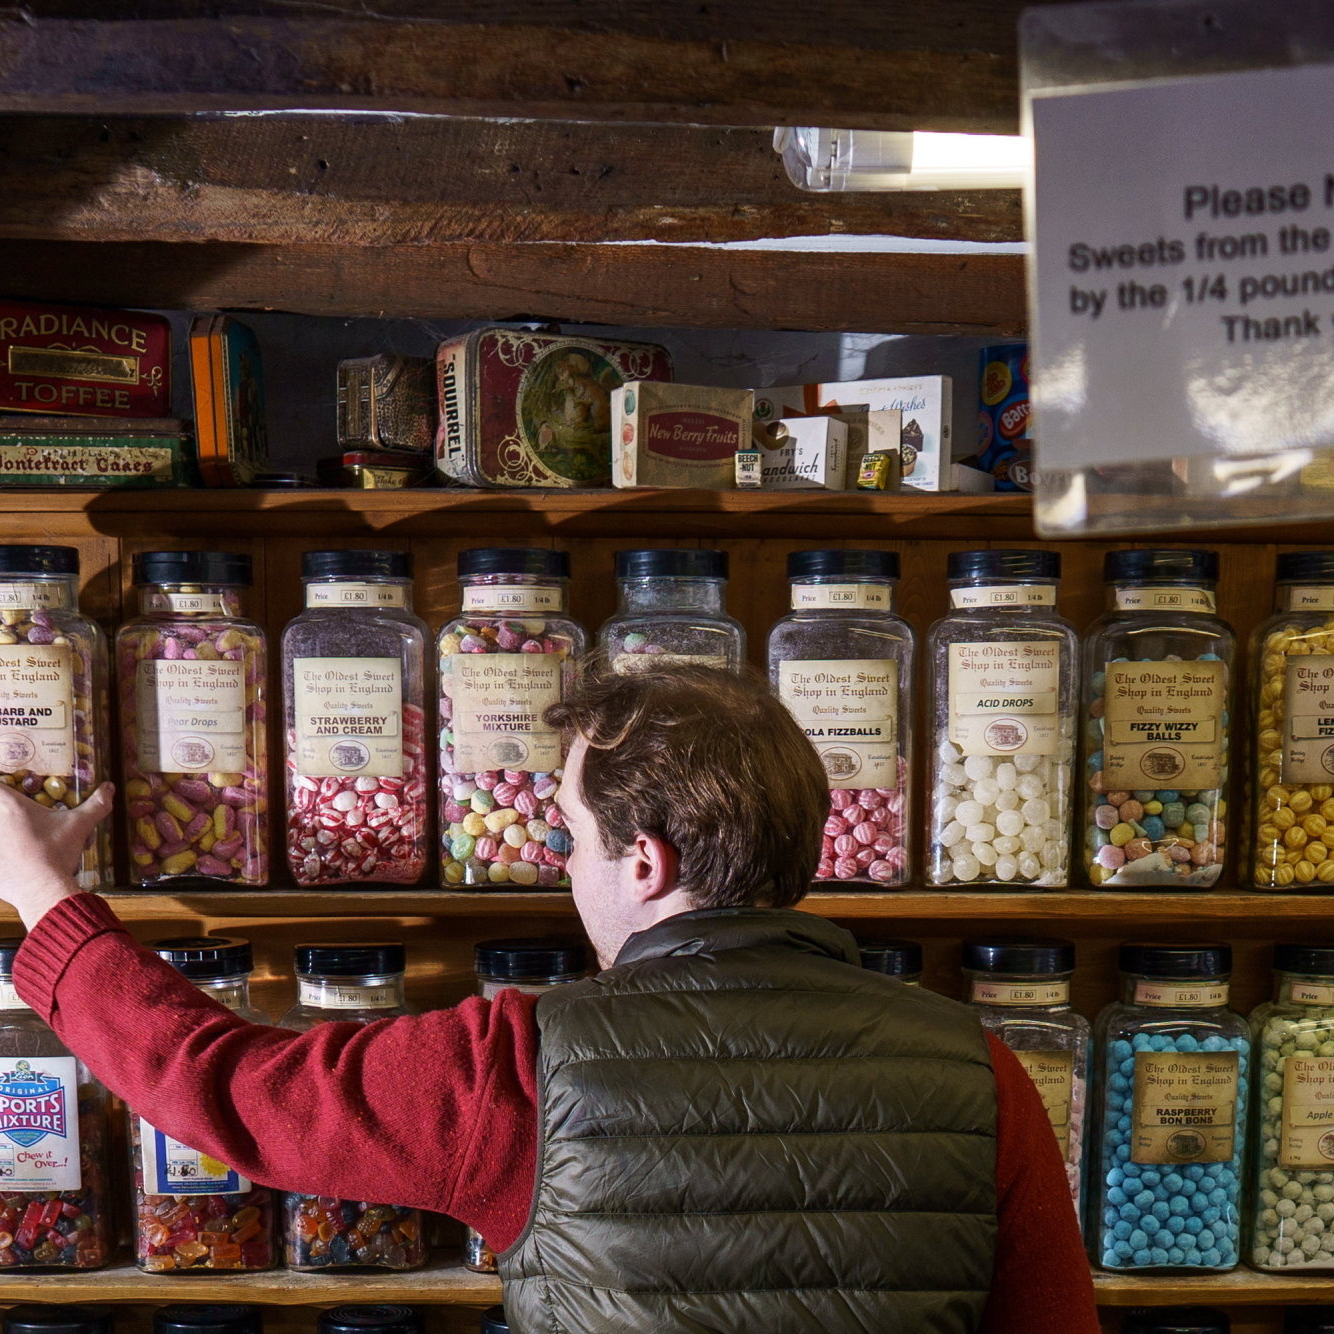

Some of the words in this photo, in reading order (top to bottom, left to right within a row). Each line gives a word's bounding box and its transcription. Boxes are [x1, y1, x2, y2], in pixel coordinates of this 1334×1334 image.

[1184, 180, 1310, 219] Please
[1070, 241, 1184, 270] Sweets
[1196, 232, 1270, 261] from
[1281, 229, 1332, 254] the
[1071, 283, 1105, 317] by
[1117, 277, 1167, 309] the
[1183, 275, 1227, 305] 1/4
[1223, 312, 1321, 343] Thank
[0, 315, 147, 353] RADIANCE
[15, 382, 131, 409] TOFFEE
[649, 425, 670, 439] New
[673, 425, 704, 445] Berry
[706, 426, 738, 443] Fruits
[780, 447, 803, 456] FRY'S
[737, 455, 758, 463] BEECH
[96, 456, 154, 473] Cakes
[739, 462, 755, 471] -NUT
[963, 596, 977, 604] Price
[994, 593, 1015, 602] £1.80
[959, 646, 978, 659] The
[981, 645, 1018, 656] Oldest
[1021, 645, 1055, 657] Sweet
[961, 659, 989, 672] Shop
[993, 659, 1004, 669] in
[1007, 659, 1053, 672] England
[977, 698, 1001, 708] ACID
[1001, 698, 1033, 708] DROPS
[28, 708, 52, 717] AND
[310, 717, 387, 726] STRAWBERRY
[476, 714, 538, 722] YORKSHIRE
[316, 726, 340, 735] AND
[343, 726, 382, 735] CREAM
[483, 723, 531, 731] MIXTURE
[827, 727, 881, 736] FIZZBALLS
[1130, 723, 1161, 731] FIZZY
[1164, 723, 1198, 731] WIZZY
[1147, 732, 1182, 741] BALLS
[1156, 1108, 1217, 1117] RASPBERRY
[1307, 1110, 1333, 1122] Apple
[1159, 1116, 1182, 1125] BON
[1186, 1116, 1213, 1125] BONS
[17, 1149, 42, 1162] Chew
[45, 1150, 53, 1159] it
